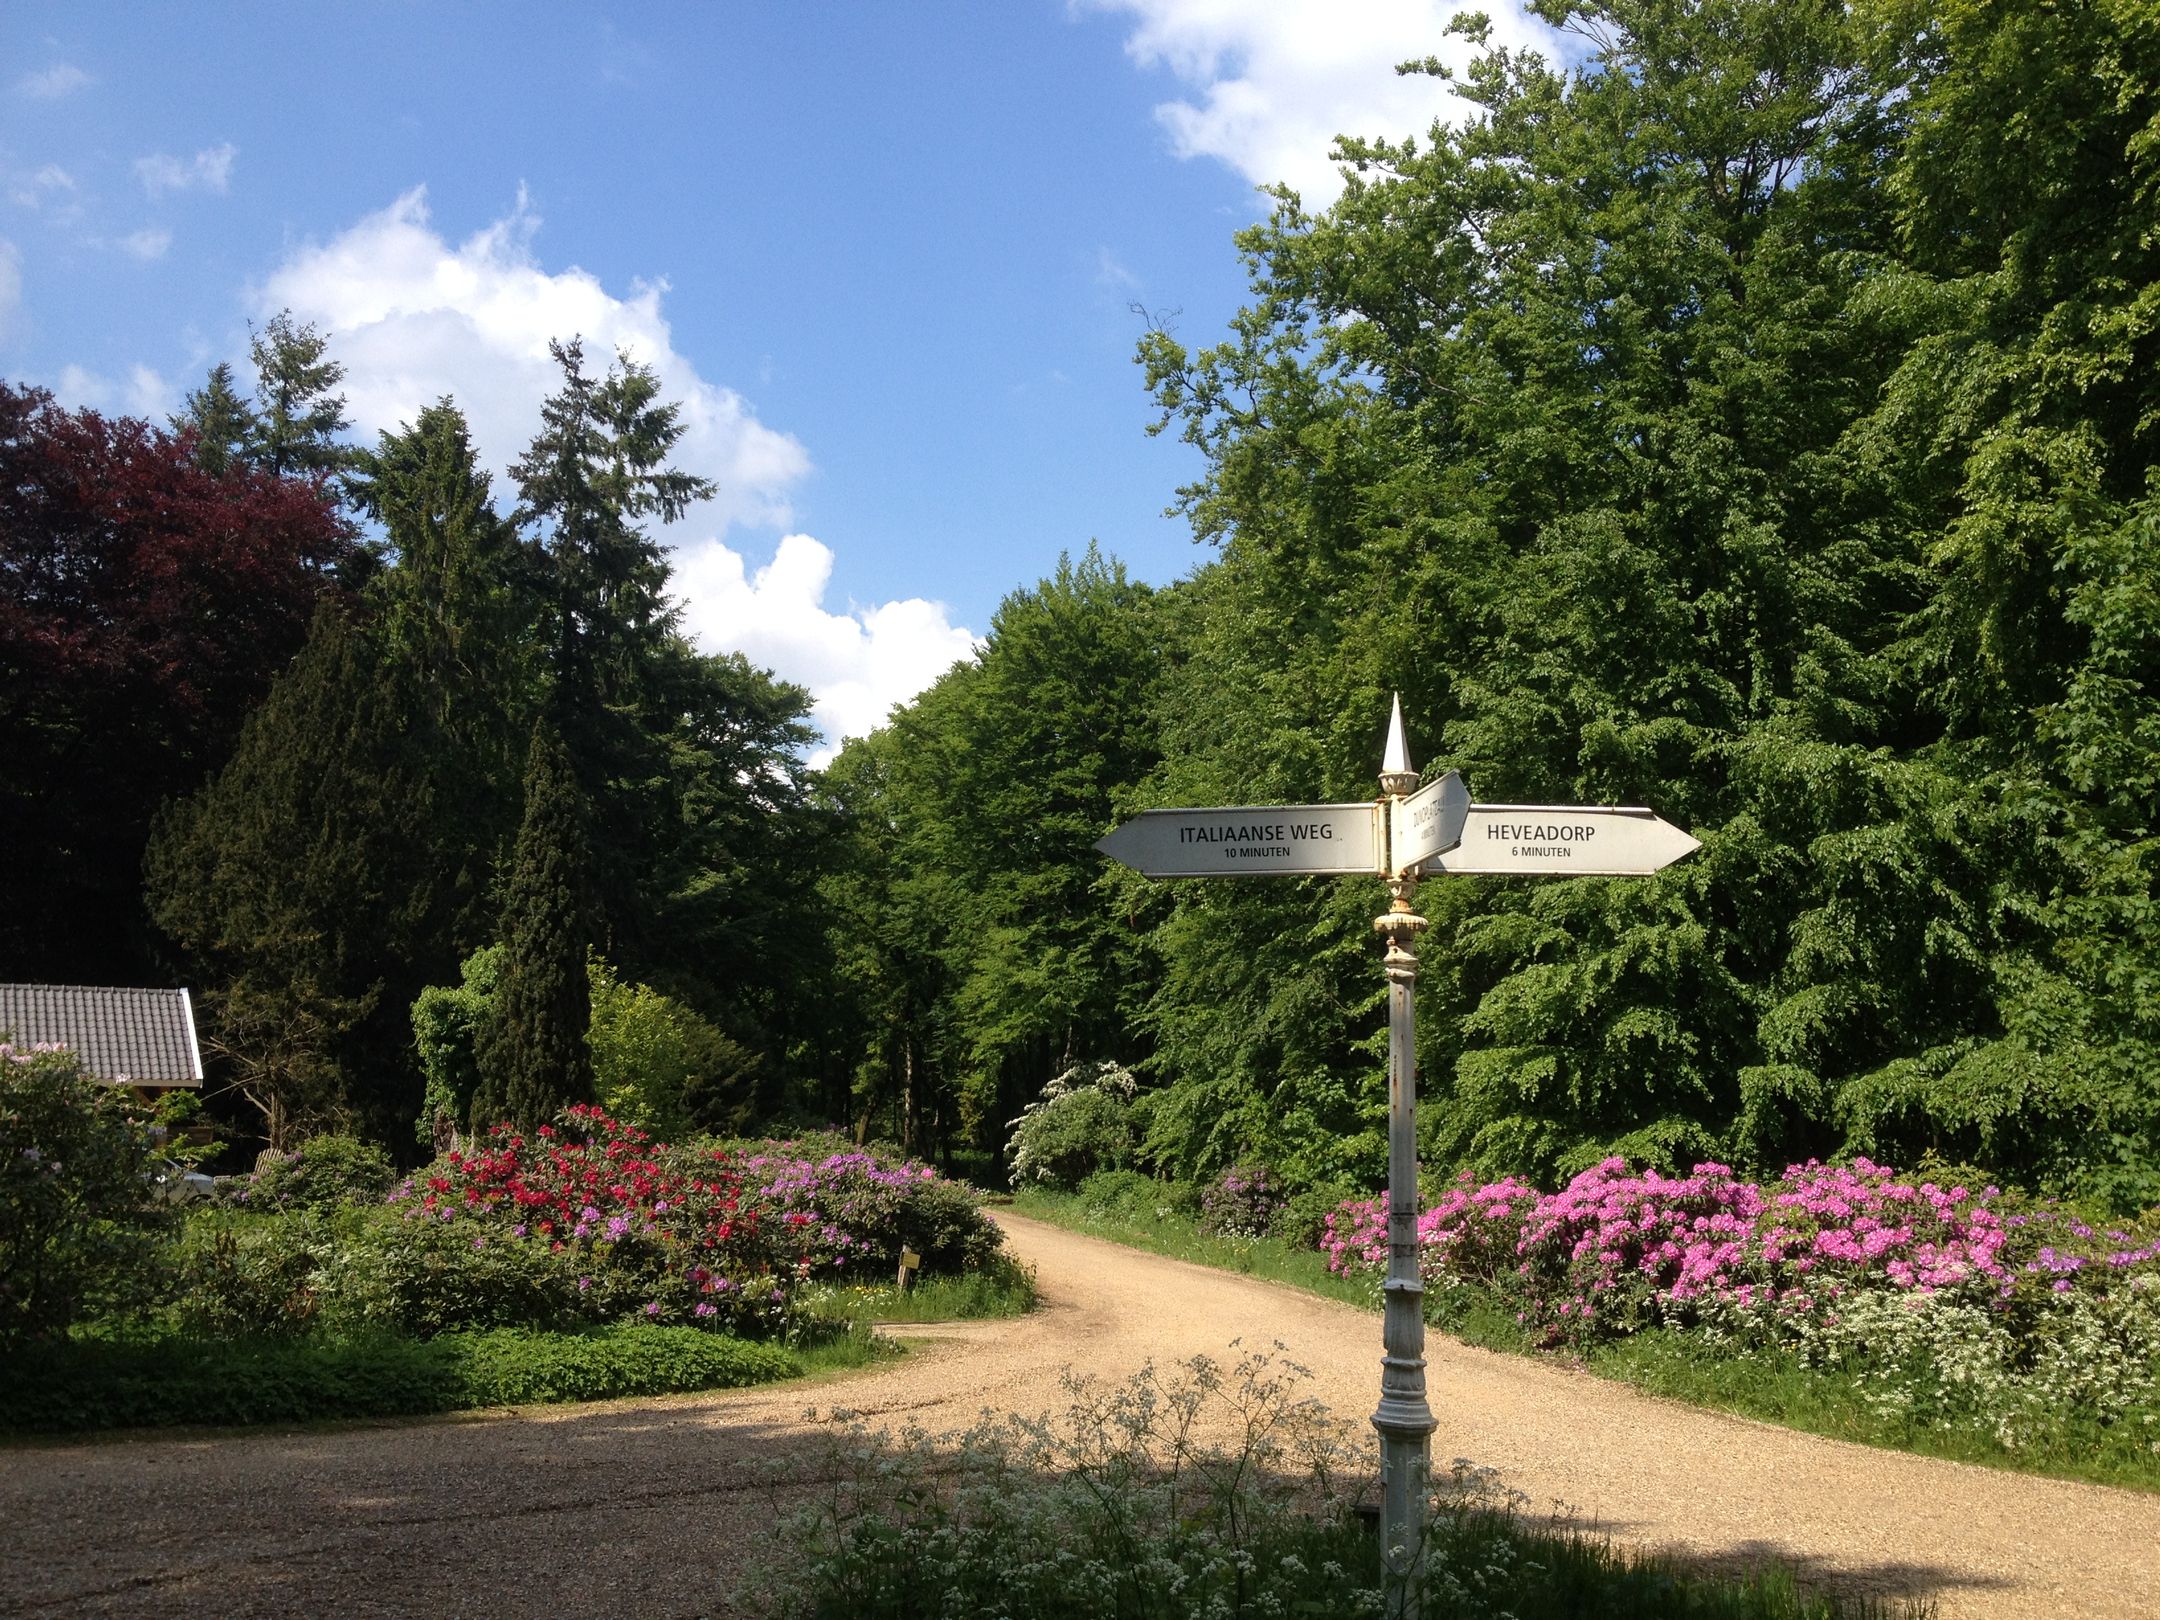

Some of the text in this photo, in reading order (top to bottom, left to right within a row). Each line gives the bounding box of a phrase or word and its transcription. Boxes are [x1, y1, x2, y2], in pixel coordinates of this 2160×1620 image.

[1180, 824, 1333, 843] ITALIAANSE WEG
[1487, 824, 1595, 842] HEVEADORP
[1225, 846, 1290, 858] 10 MINUTEN
[1511, 847, 1571, 857] 6 MINUTEN
